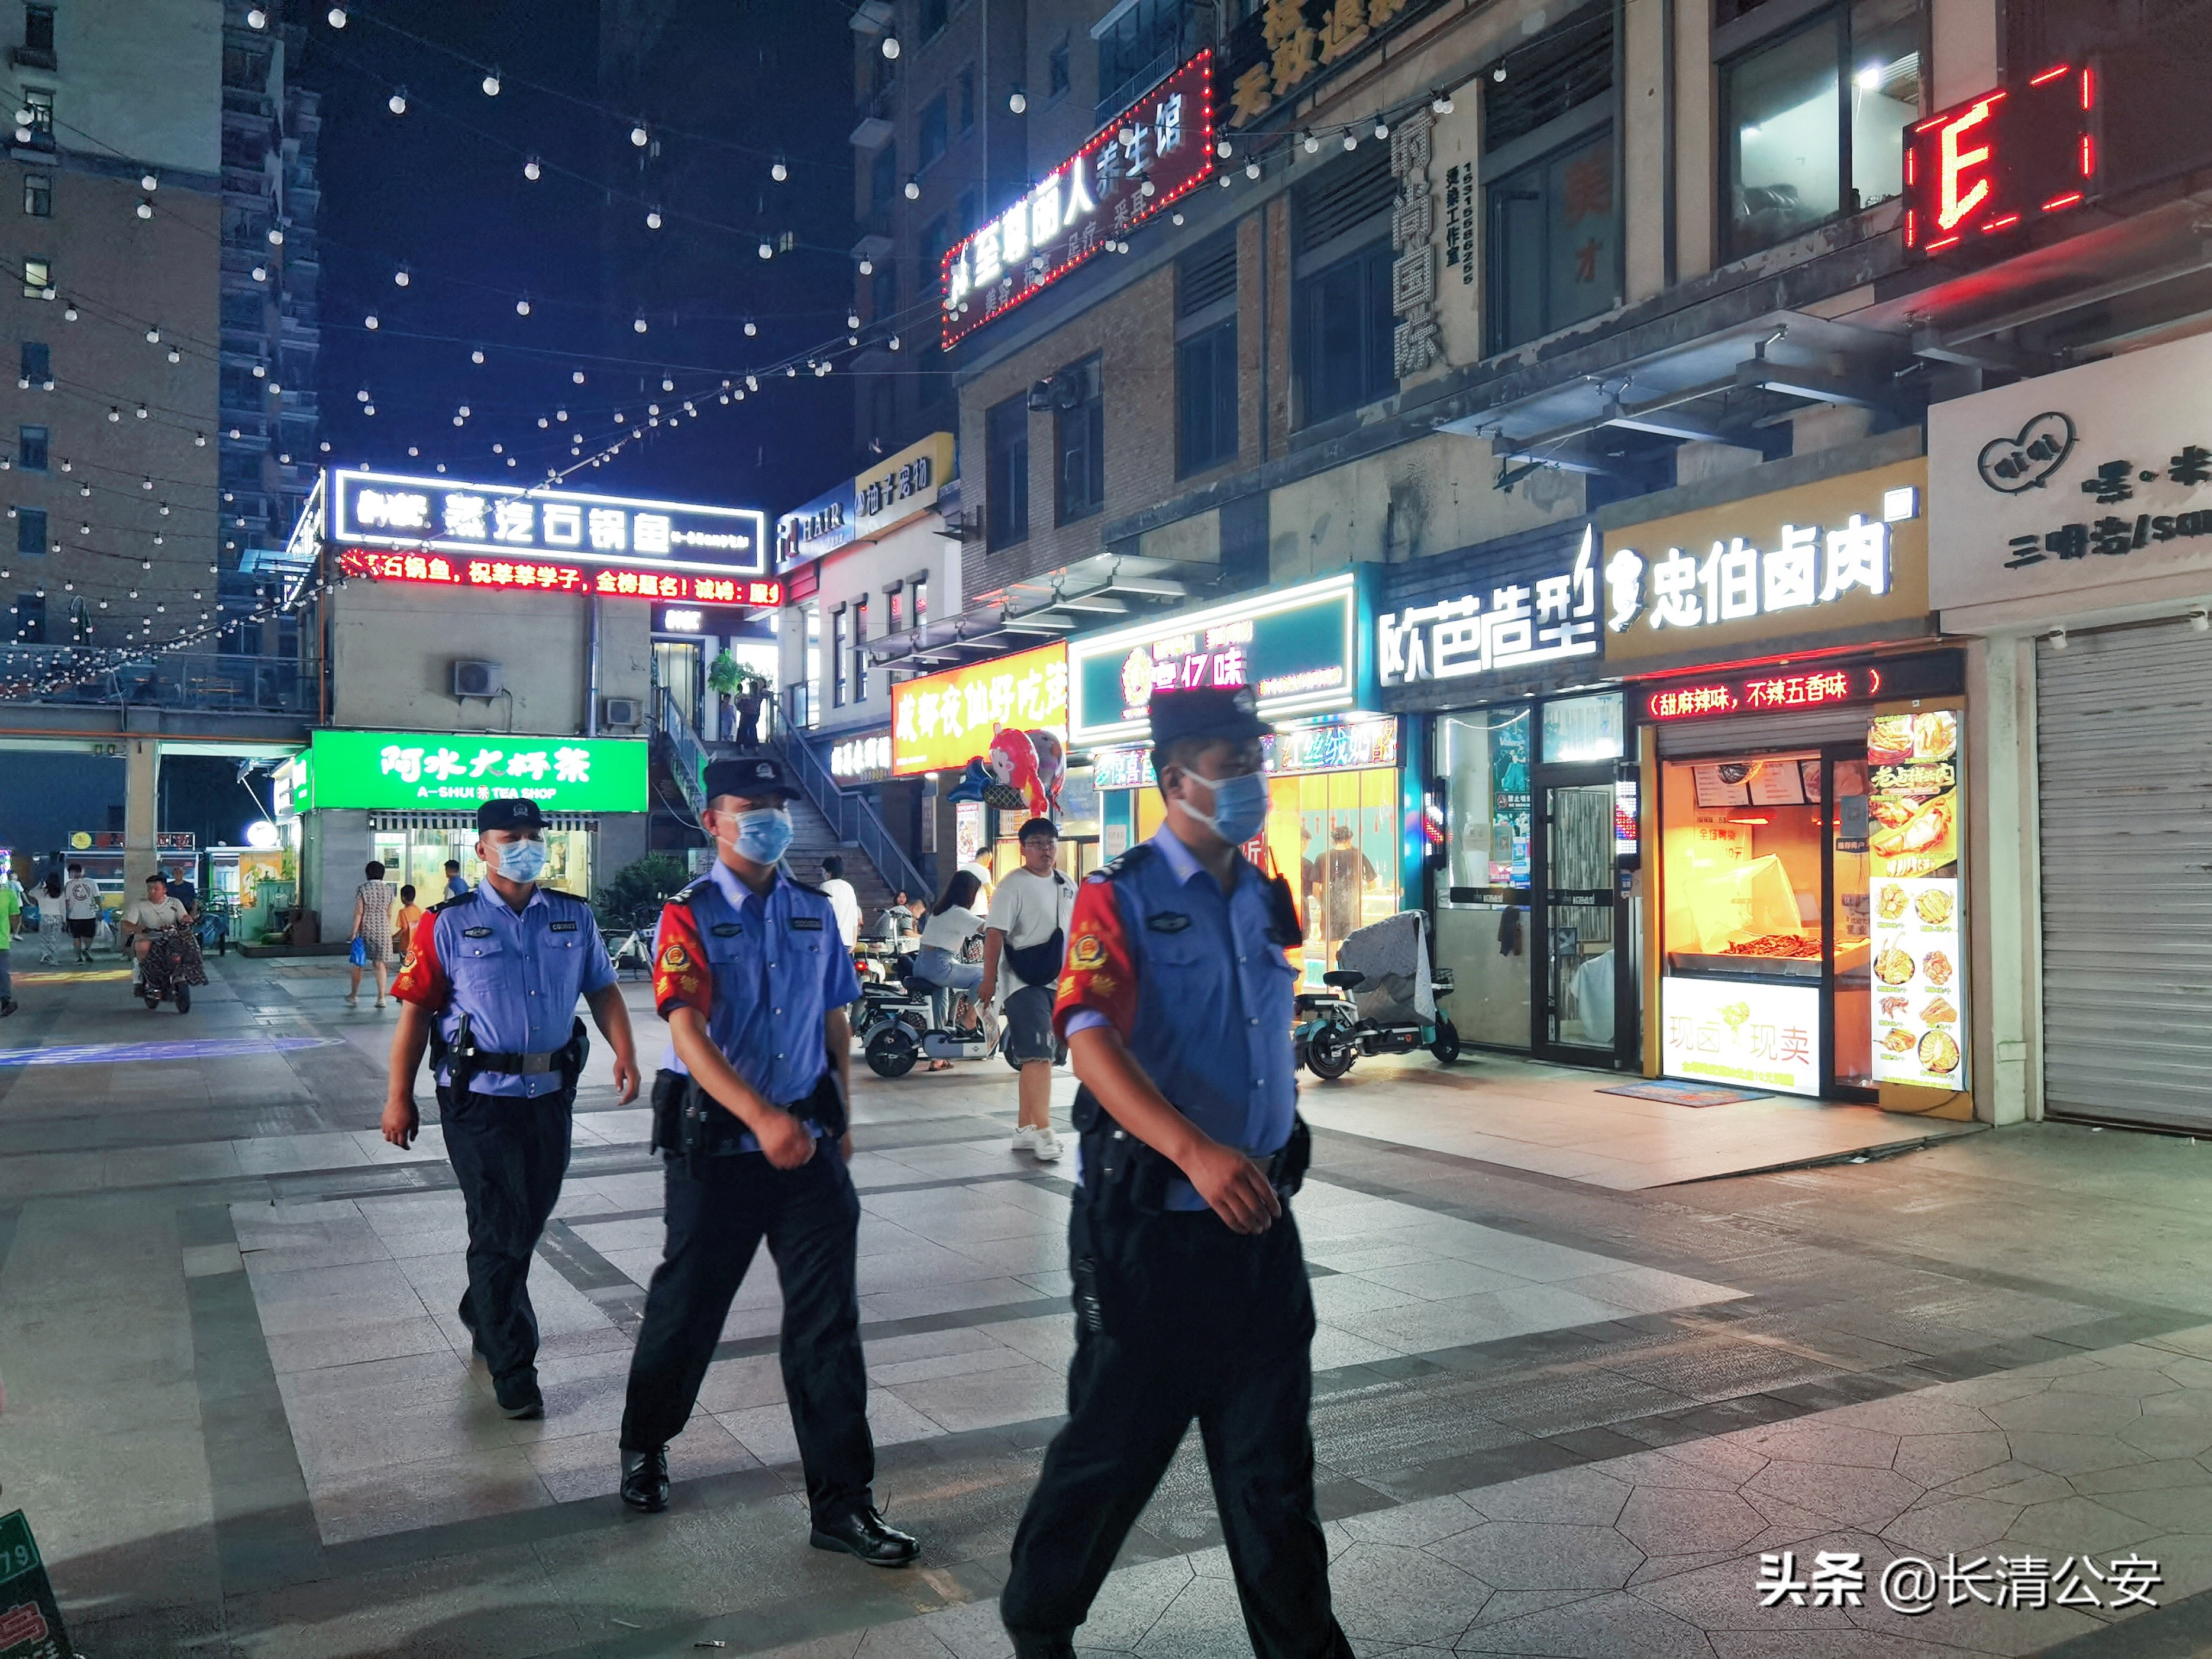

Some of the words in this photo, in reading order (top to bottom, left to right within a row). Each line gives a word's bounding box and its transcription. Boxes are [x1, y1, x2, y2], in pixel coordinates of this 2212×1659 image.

[802, 503, 844, 543] HAIR
[1650, 513, 1893, 630] 忠伯卤肉
[1378, 522, 1598, 687] 欧芭造型
[380, 744, 591, 785] 阿水大杯茶
[491, 787, 518, 799] TEA
[521, 787, 557, 801] SHOP
